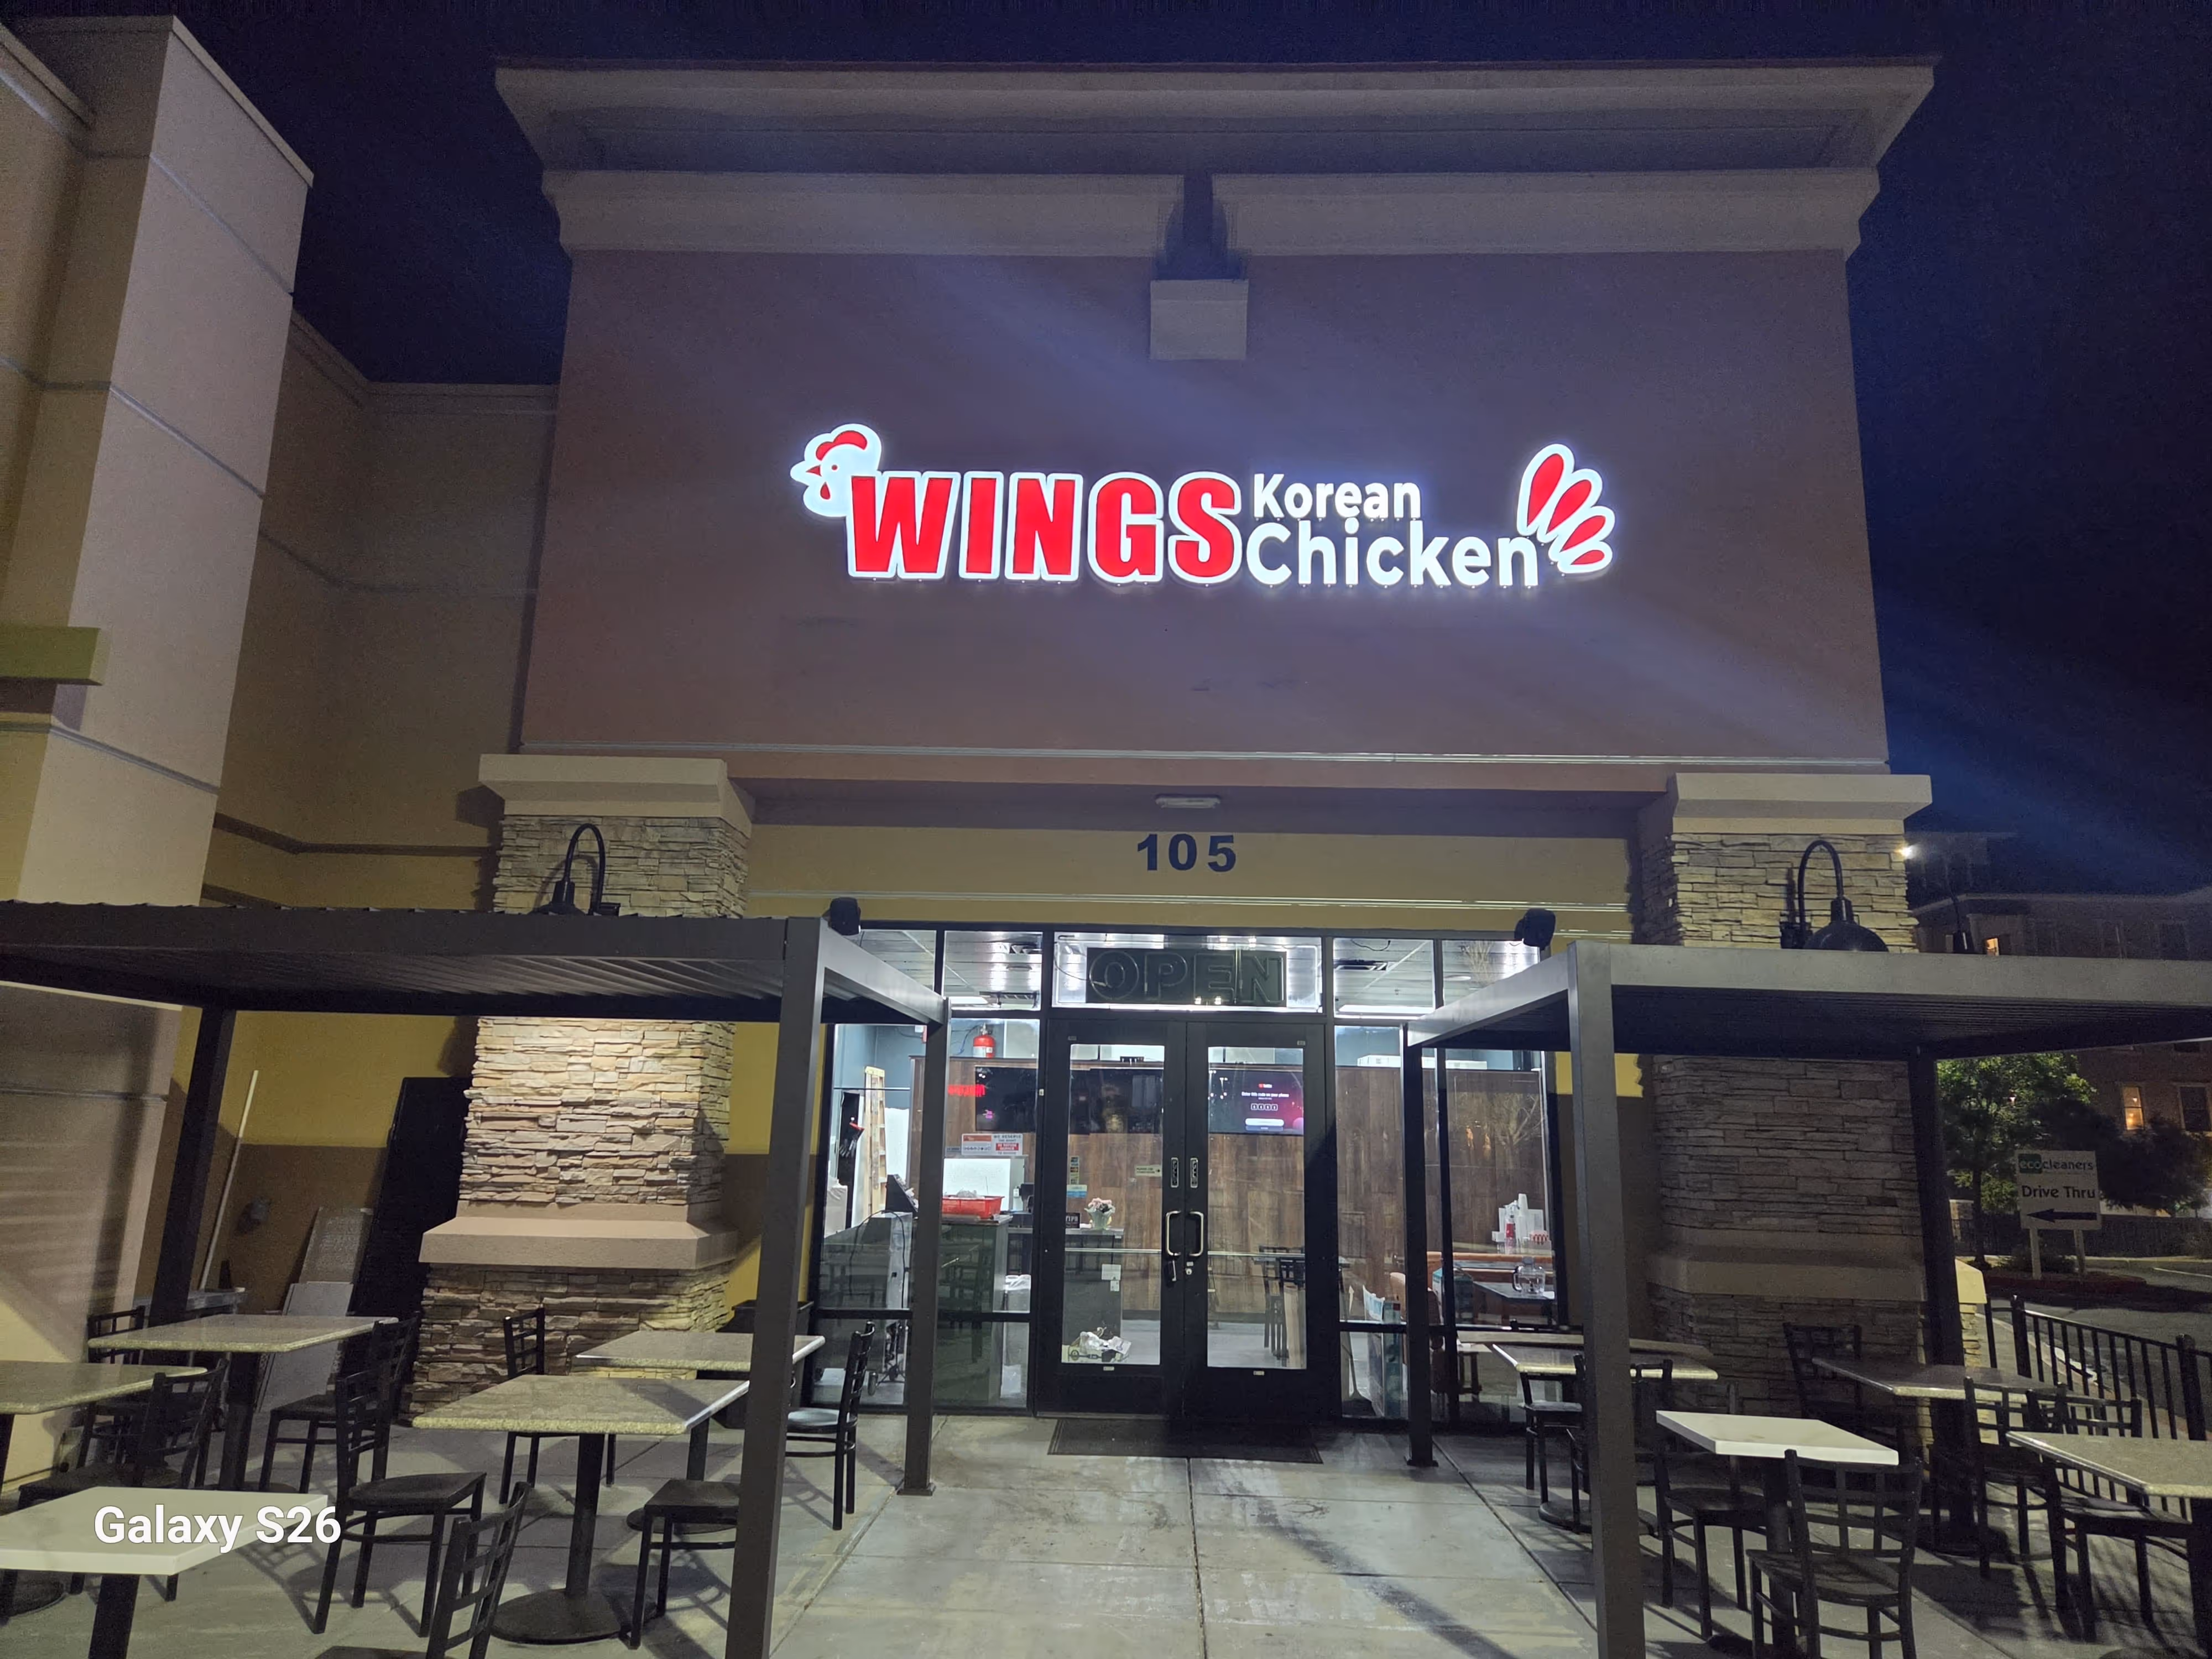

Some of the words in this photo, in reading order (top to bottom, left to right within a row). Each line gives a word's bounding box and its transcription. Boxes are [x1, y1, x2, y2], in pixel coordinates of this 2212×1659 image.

[1253, 473, 1422, 520] Korean
[847, 471, 1239, 585] WINGS
[1246, 519, 1540, 588] Chicken
[1138, 833, 1236, 872] 105
[1089, 951, 1284, 1004] OPEN
[2021, 1185, 2059, 1198] Drive
[2063, 1186, 2095, 1198] Thru
